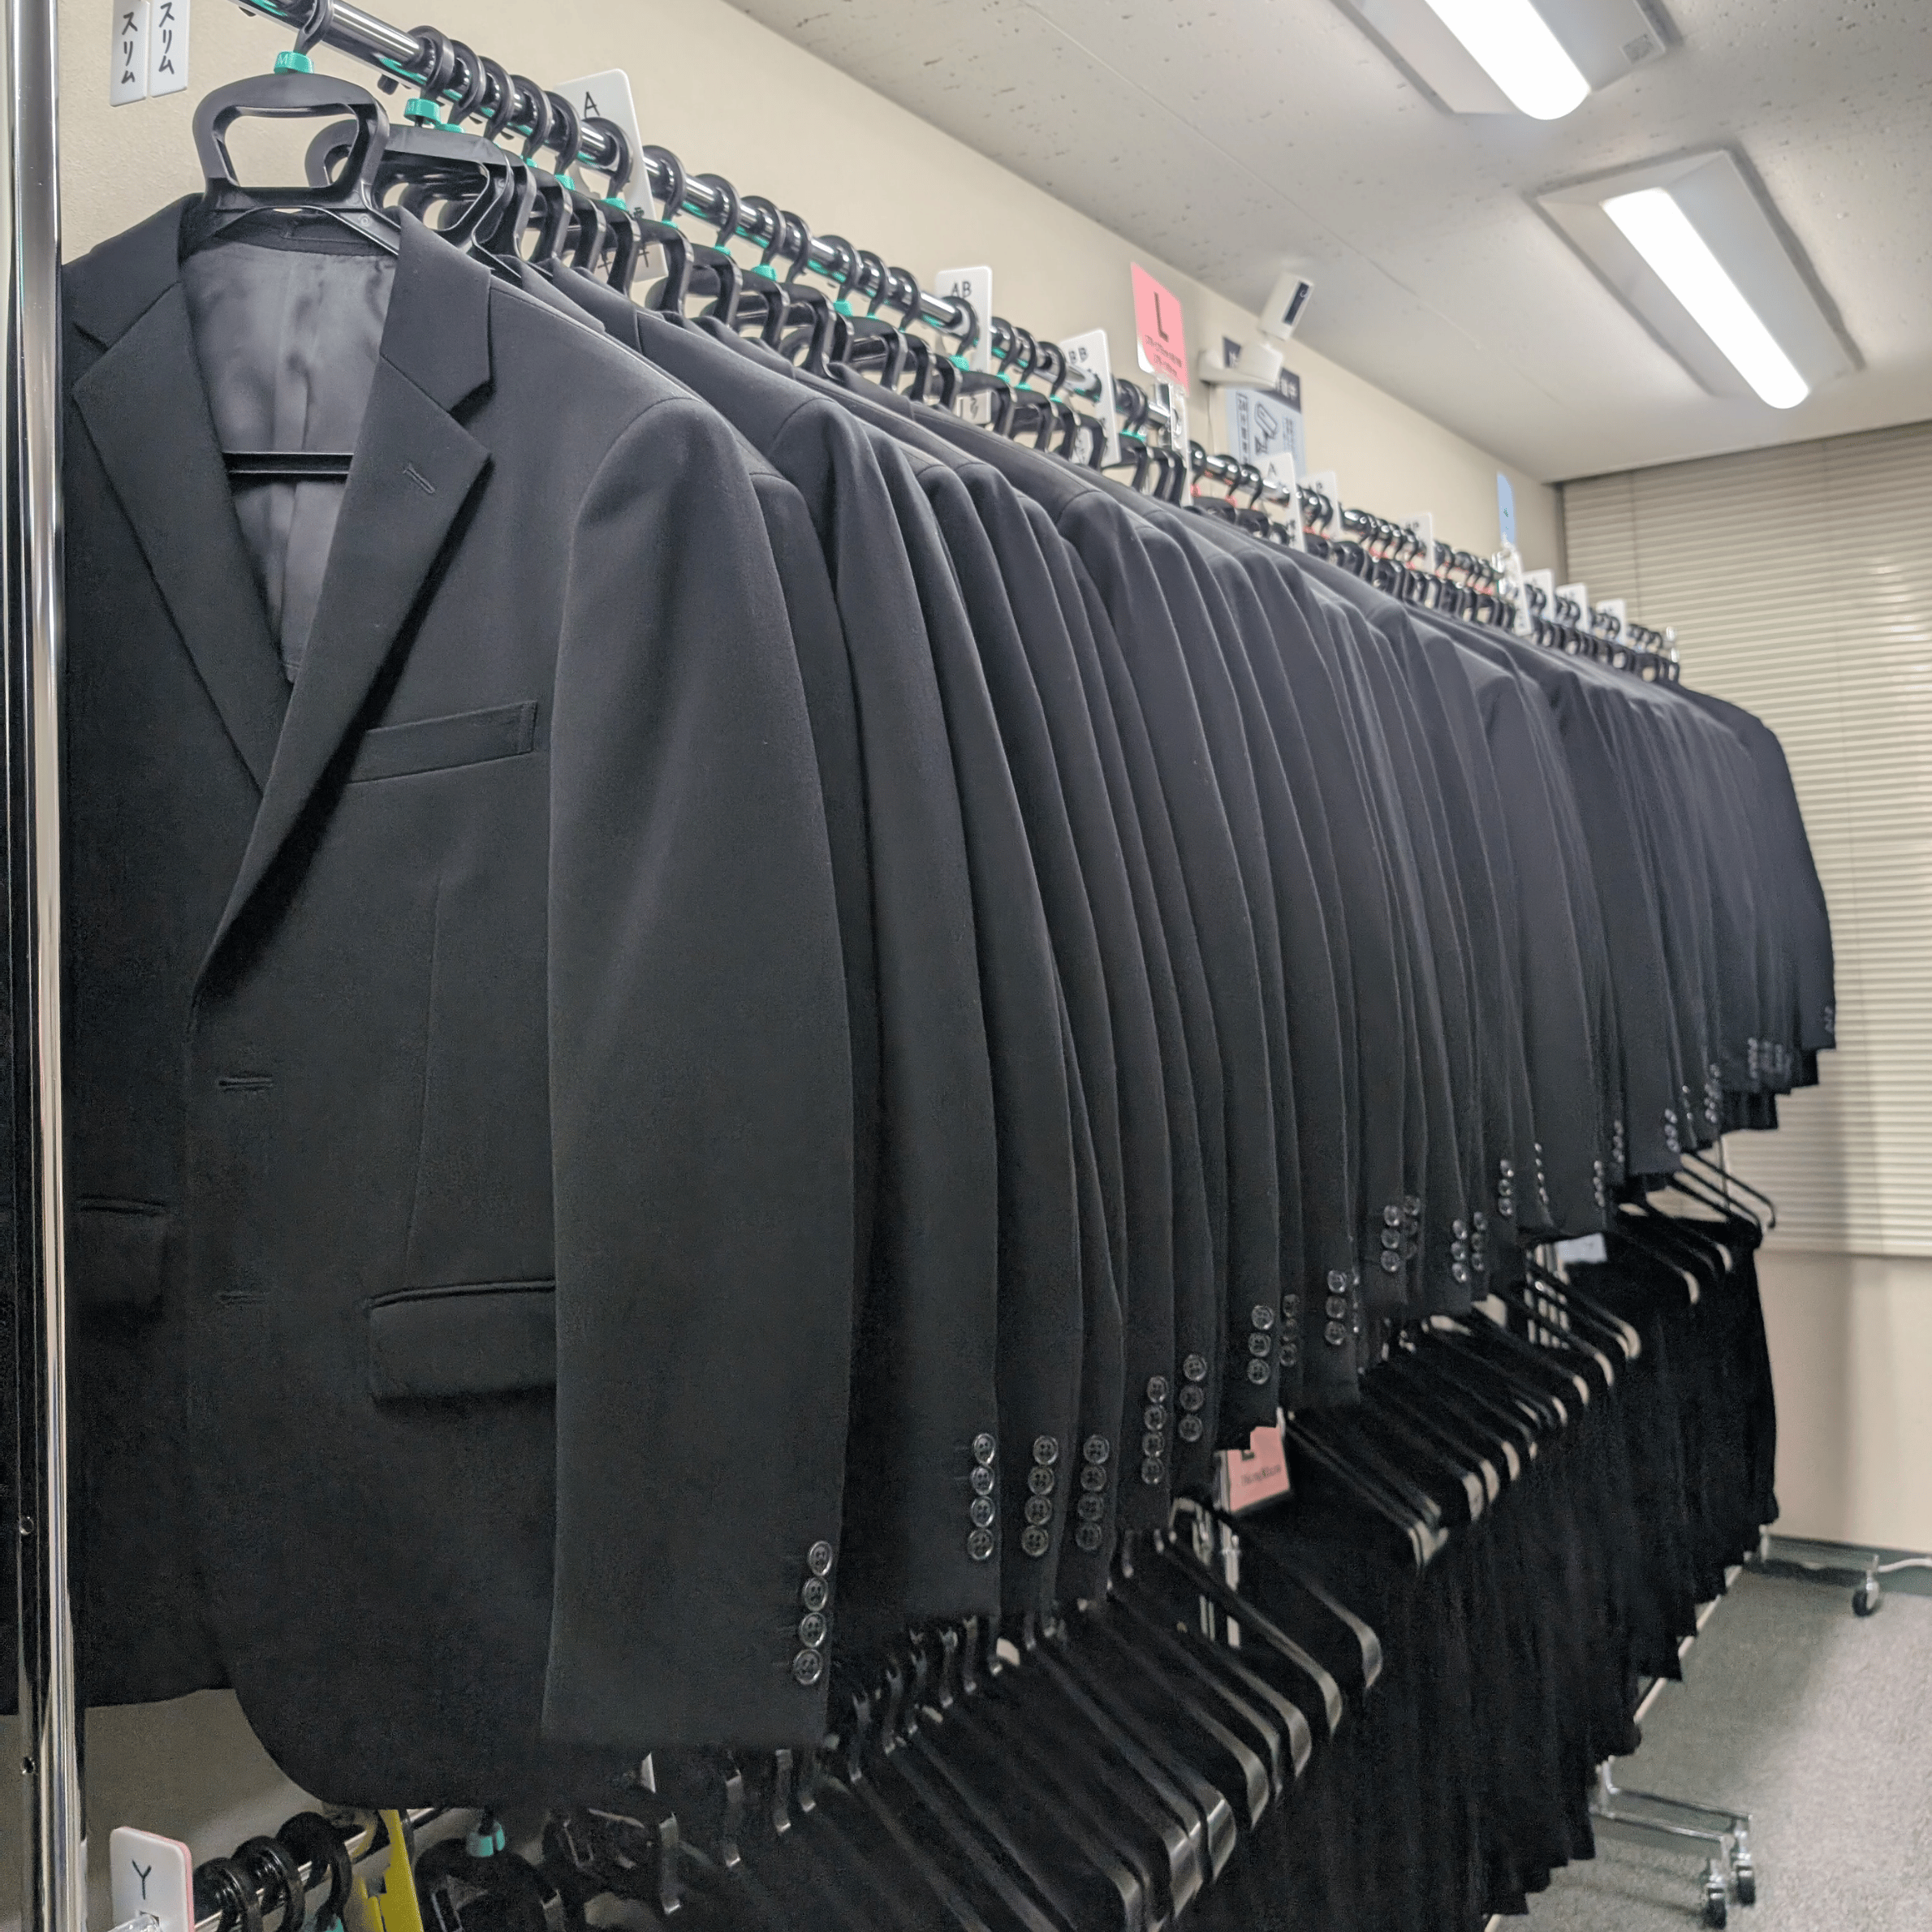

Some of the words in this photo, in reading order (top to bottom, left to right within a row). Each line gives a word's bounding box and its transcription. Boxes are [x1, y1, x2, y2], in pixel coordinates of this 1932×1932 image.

[121, 11, 138, 84] スリム
[158, 2, 175, 75] スリム
[584, 91, 601, 119] A
[950, 280, 972, 299] AB
[1154, 291, 1169, 343] L
[132, 1859, 152, 1900] Y
